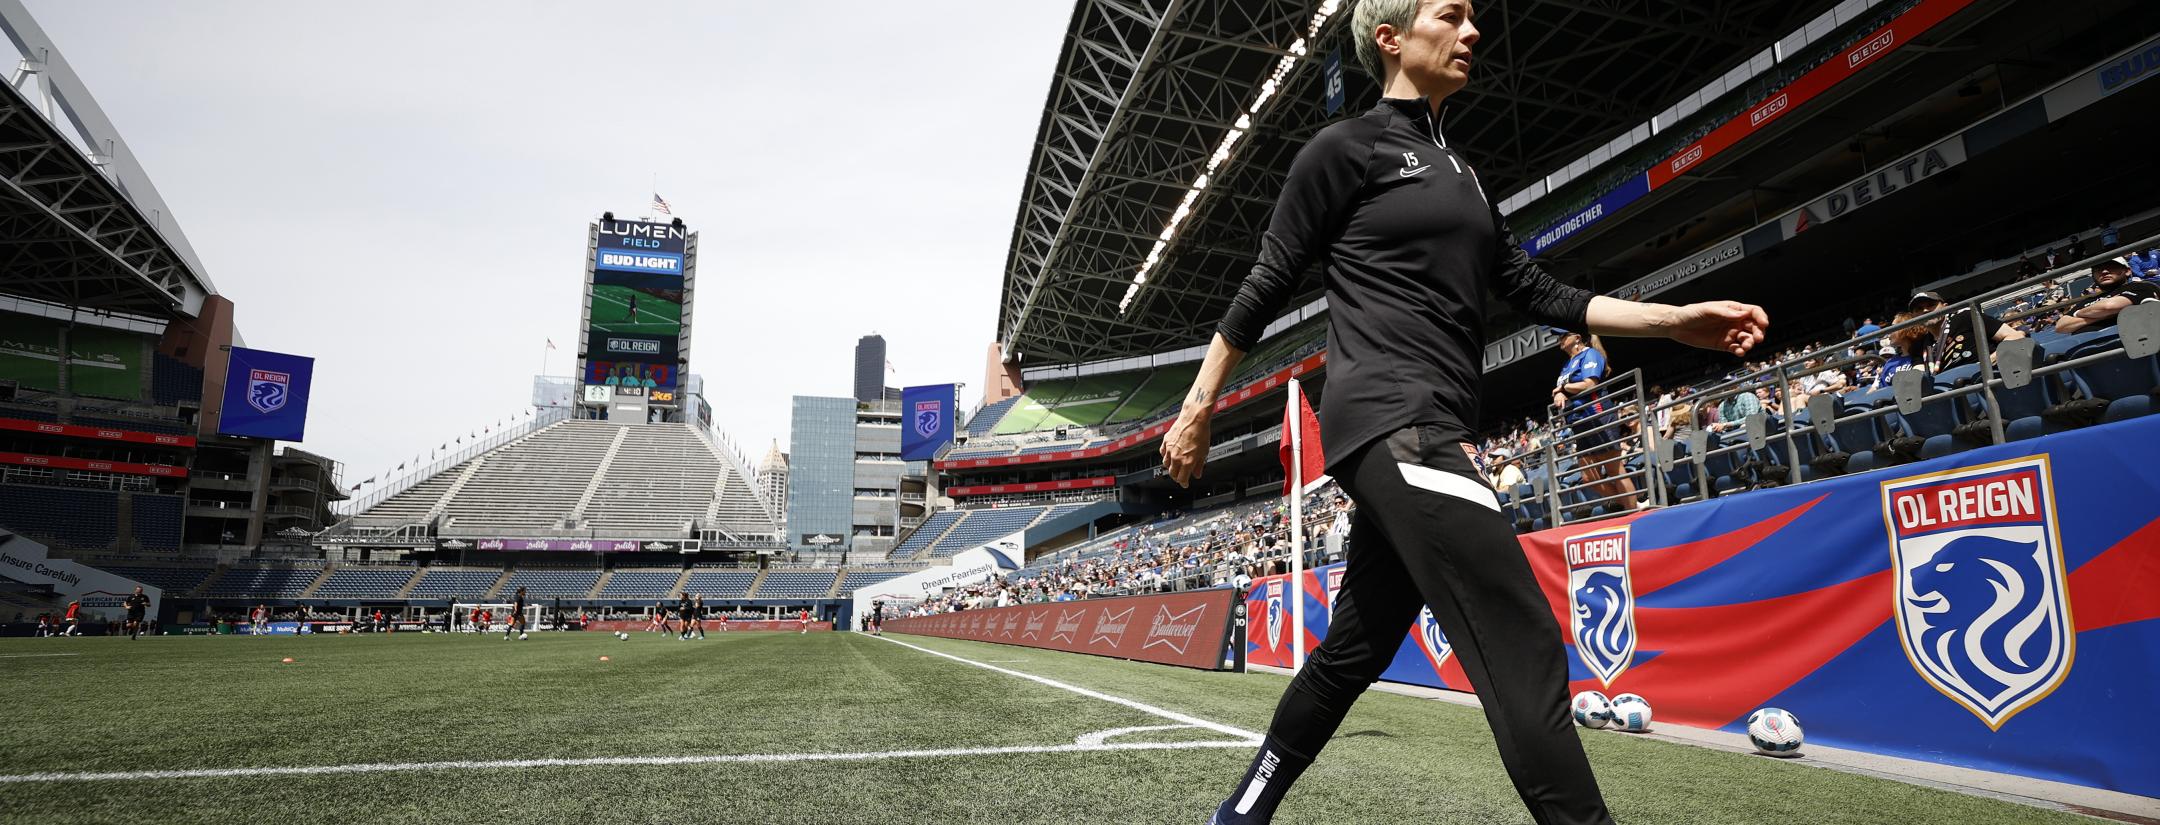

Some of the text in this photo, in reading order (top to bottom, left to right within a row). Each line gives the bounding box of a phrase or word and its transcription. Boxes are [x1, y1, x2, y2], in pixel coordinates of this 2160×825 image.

[1851, 32, 1891, 63] BECU
[1327, 69, 1342, 99] 45
[1754, 97, 1786, 123] BECU
[1403, 152, 1419, 167] 15
[1674, 149, 1700, 169] BECU
[1827, 149, 1947, 217] DELTA
[600, 221, 686, 240] LUMEN
[1535, 203, 1603, 251] #BOLDTOGETHER
[623, 238, 660, 248] FIELD
[603, 254, 677, 269] BUD LIGHT
[1640, 273, 1674, 294] Amazon
[1676, 263, 1697, 279] Web
[1699, 246, 1740, 270] Services
[620, 340, 658, 352] OL REIGN
[1485, 328, 1559, 370] LUME
[264, 373, 286, 383] REIGN
[1895, 363, 1912, 373] REI
[1264, 429, 1283, 444] veriz
[1897, 477, 2035, 529] OL REIGN
[1569, 537, 1623, 565] OL REIGN
[1, 552, 80, 587] Insure Carefully
[921, 563, 993, 590] Dream Fearlessly
[1150, 614, 1196, 637] Budweiser
[1235, 618, 1246, 627] 10
